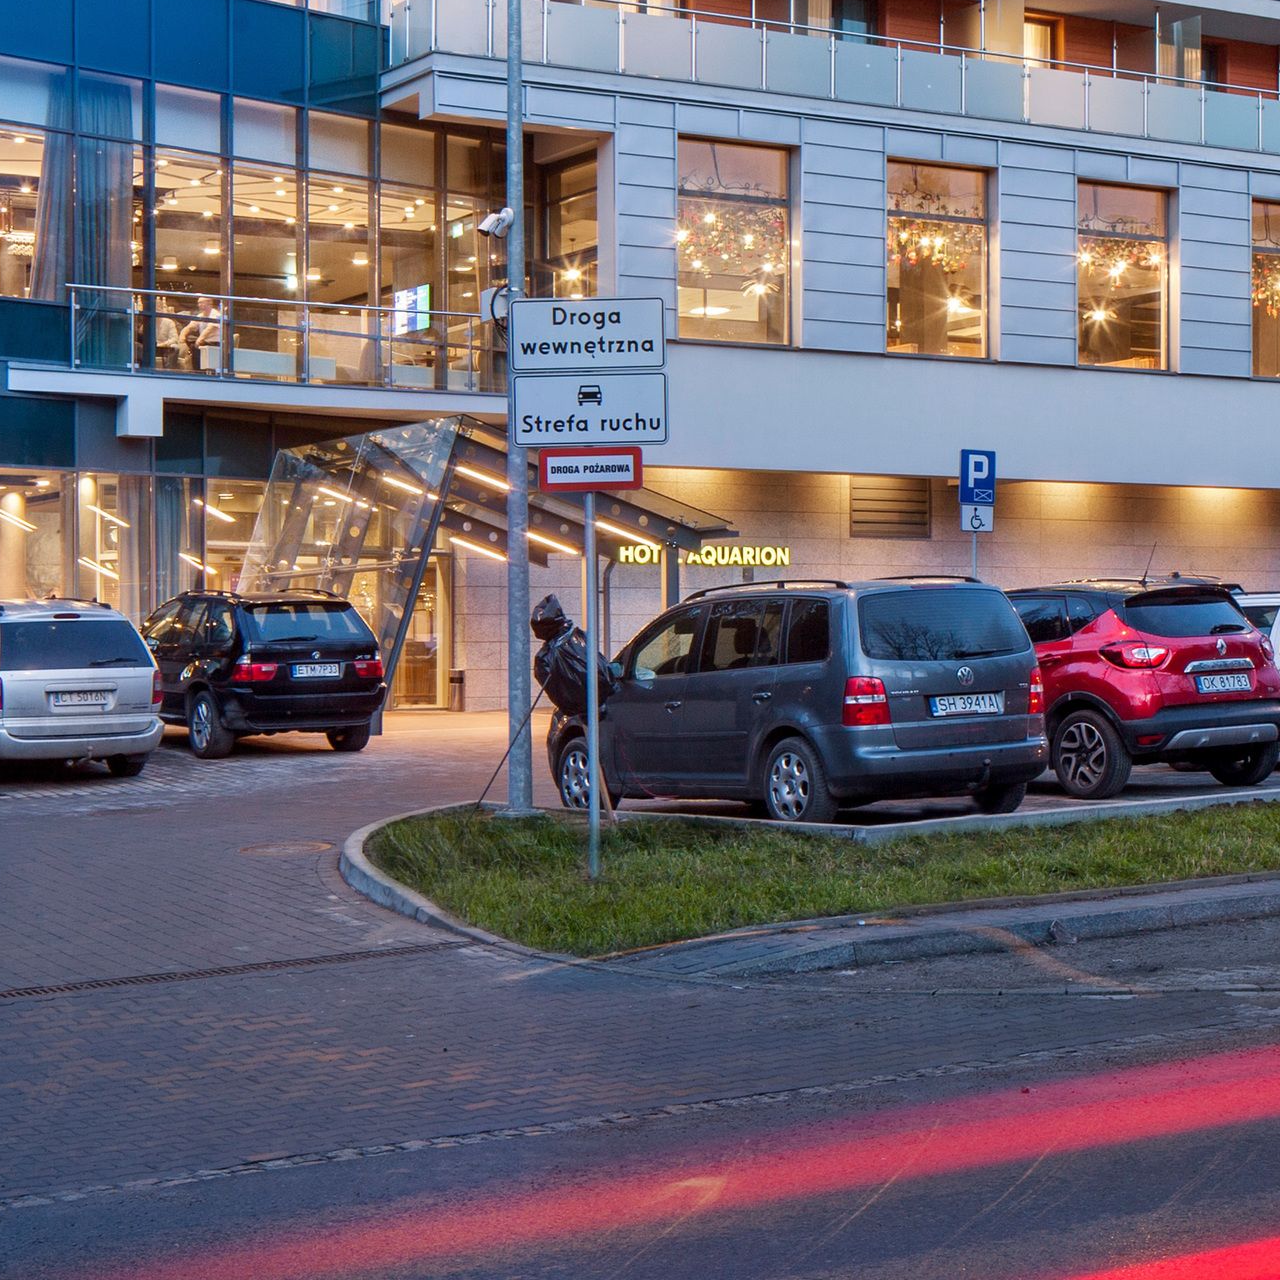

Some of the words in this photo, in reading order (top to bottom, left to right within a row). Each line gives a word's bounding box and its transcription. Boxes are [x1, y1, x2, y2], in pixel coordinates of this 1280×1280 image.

[552, 306, 621, 330] Droga
[521, 336, 655, 359] wewnętrzna
[521, 414, 589, 434] Strefa
[600, 412, 661, 432] ruchu
[550, 464, 580, 475] DROGA
[583, 462, 631, 474] POŻAROWA
[968, 454, 989, 488] P
[619, 544, 684, 564] HOT
[686, 545, 791, 567] AQUARION
[939, 696, 957, 712] SH
[960, 694, 996, 710] 3941A
